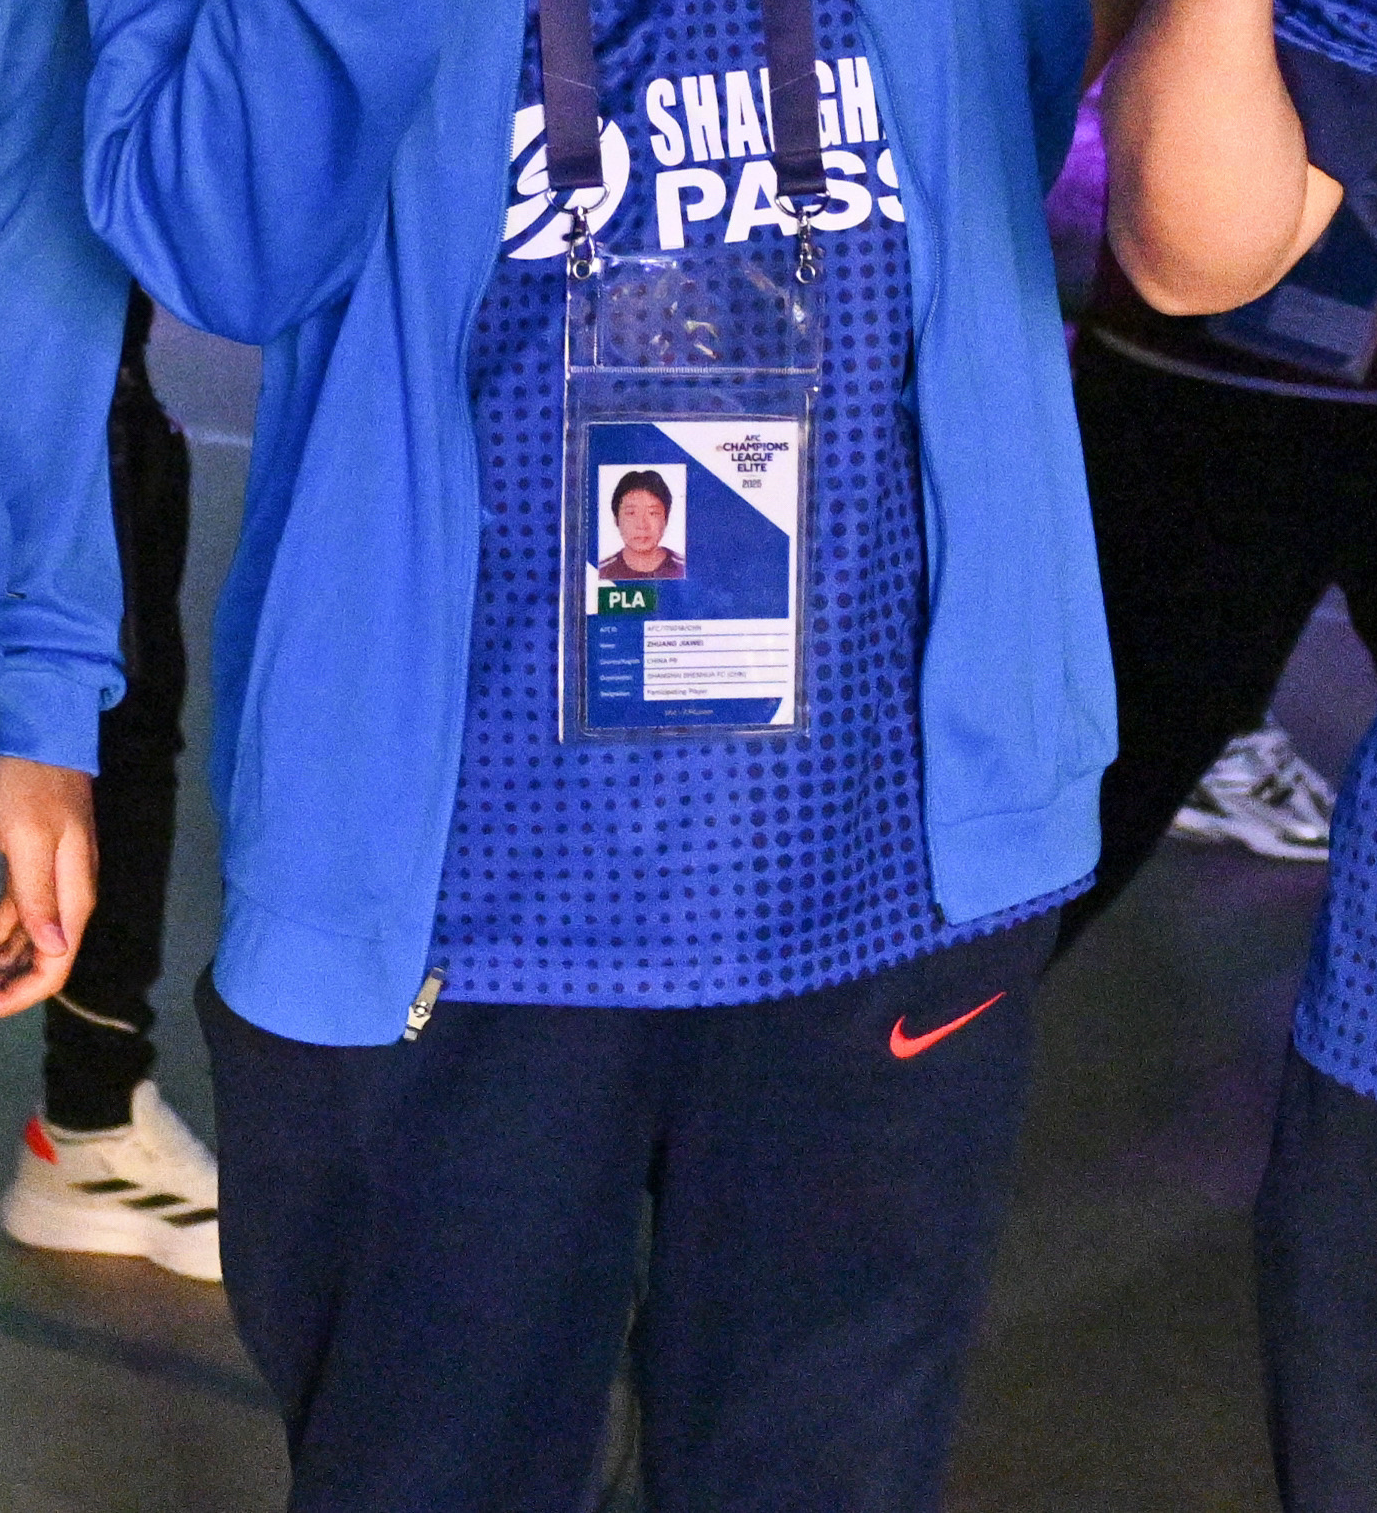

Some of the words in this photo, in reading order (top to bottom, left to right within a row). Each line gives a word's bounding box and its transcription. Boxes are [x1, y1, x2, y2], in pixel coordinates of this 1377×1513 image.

[645, 55, 888, 167] SHAGH
[744, 434, 761, 442] AFC
[731, 452, 774, 462] LEAGUE
[737, 463, 767, 473] ELITE
[608, 590, 646, 609] PLA
